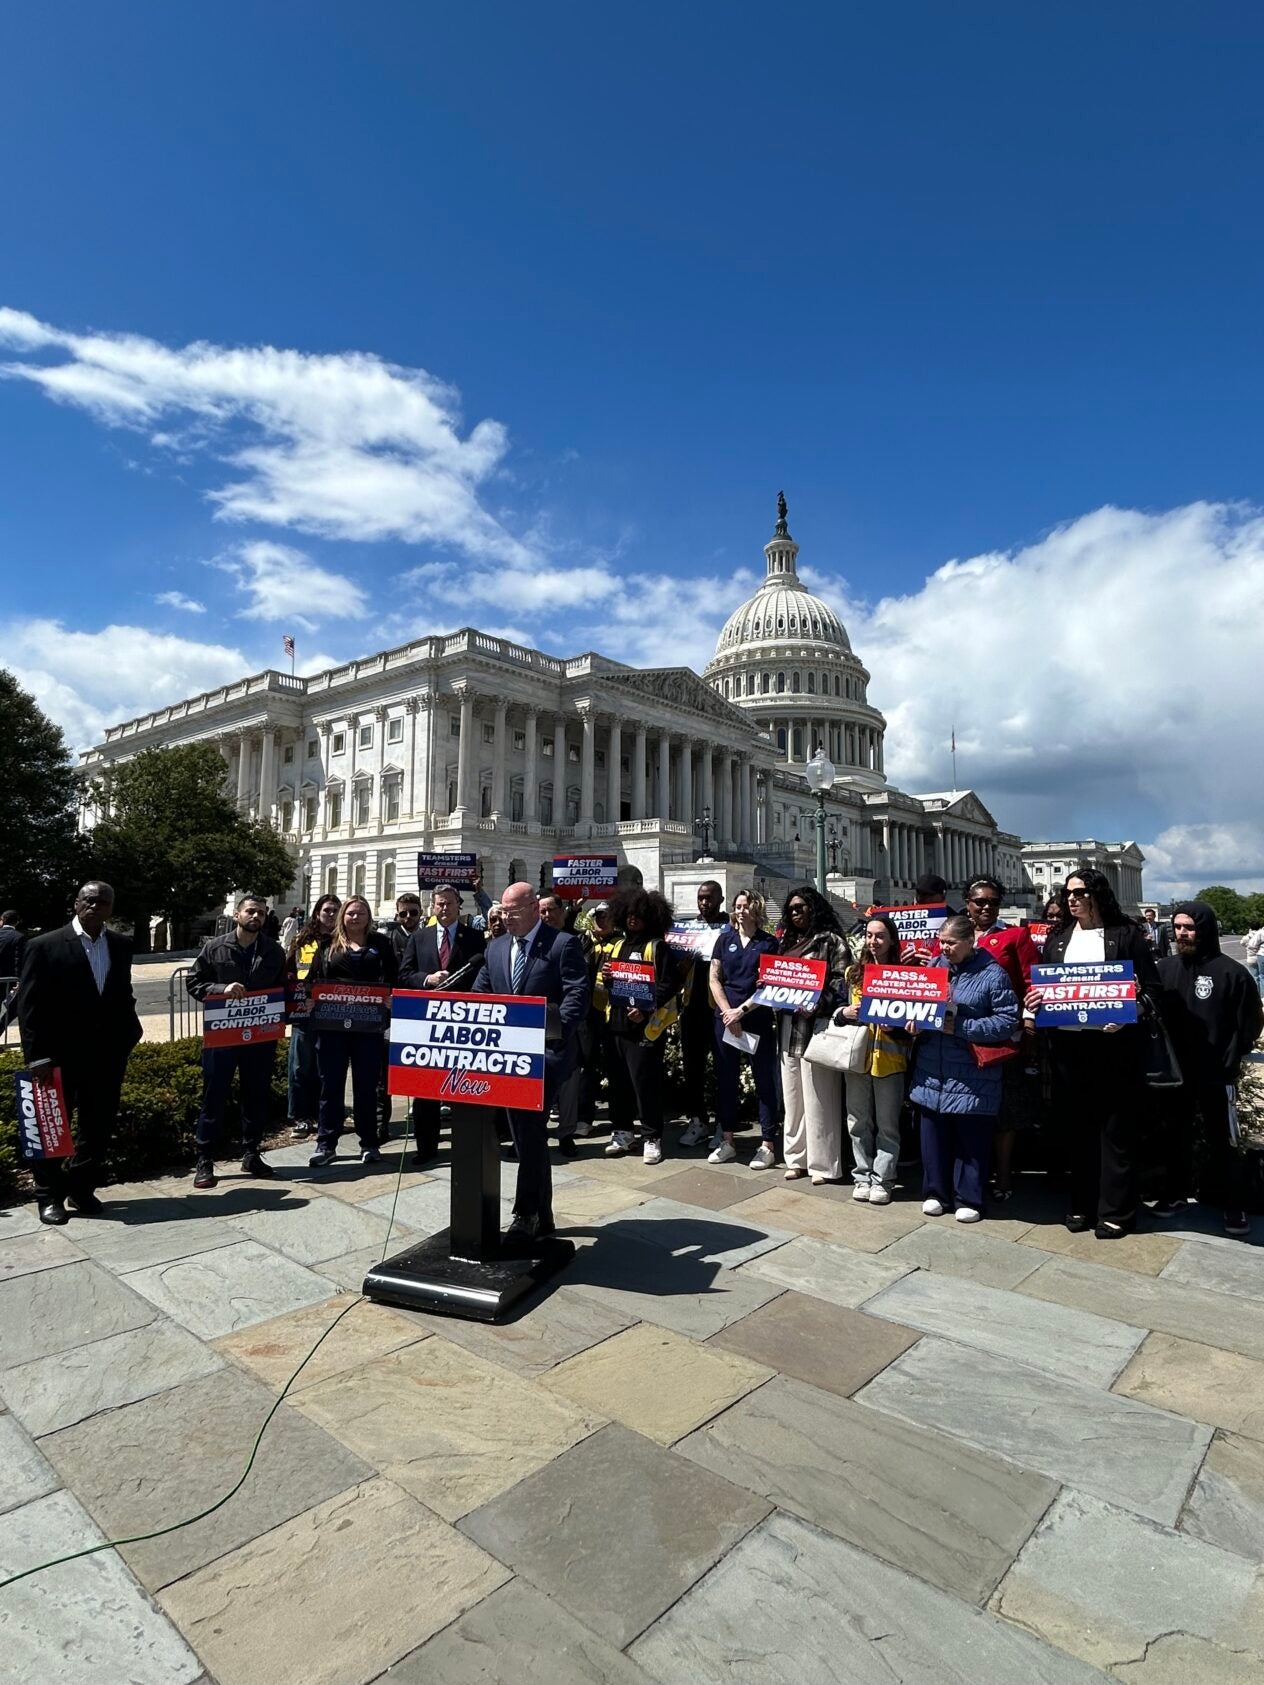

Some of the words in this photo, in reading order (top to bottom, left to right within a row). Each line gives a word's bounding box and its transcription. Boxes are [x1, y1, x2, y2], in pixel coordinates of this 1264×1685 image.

[567, 859, 603, 867] FASTER
[419, 867, 444, 876] FAST
[445, 868, 475, 877] FIRST
[570, 868, 601, 876] LABOR
[557, 877, 614, 886] CONTRACTS
[888, 909, 929, 920] FASTER
[897, 920, 928, 930] ABOR
[664, 934, 695, 945] FAST
[619, 962, 642, 973] FAIR
[774, 960, 802, 970] PASS
[1038, 964, 1124, 976] TEAMSTERS
[766, 967, 793, 977] FASTER
[793, 971, 817, 980] LABOR
[882, 970, 918, 981] PASS
[918, 973, 928, 982] the
[1060, 974, 1101, 983] demand
[762, 974, 804, 985] CONTRACTS
[804, 979, 820, 987] ACT
[871, 979, 906, 988] FASTER
[907, 981, 938, 990] LABOR
[333, 984, 371, 995] FAIR
[759, 985, 815, 1006] NOW!
[866, 986, 922, 997] CONTRACTS
[1037, 986, 1077, 1000] FAST
[1078, 984, 1131, 998] FIRST
[225, 994, 269, 1008] FASTER
[318, 993, 383, 1004] CONTRACTS
[227, 1006, 266, 1018] LABOR
[425, 1000, 508, 1024] FASTER
[867, 998, 938, 1023] NOW!
[1045, 1001, 1124, 1012] CONTRACTS
[210, 1013, 281, 1030] CONTRACTS
[429, 1024, 502, 1048] LABOR
[400, 1045, 532, 1076] CONTRACTS
[440, 1065, 491, 1095] Now
[47, 1088, 63, 1126] PASS
[19, 1079, 43, 1150] NOW!
[47, 1116, 60, 1147] LABOR
[44, 1134, 54, 1153] ACT
